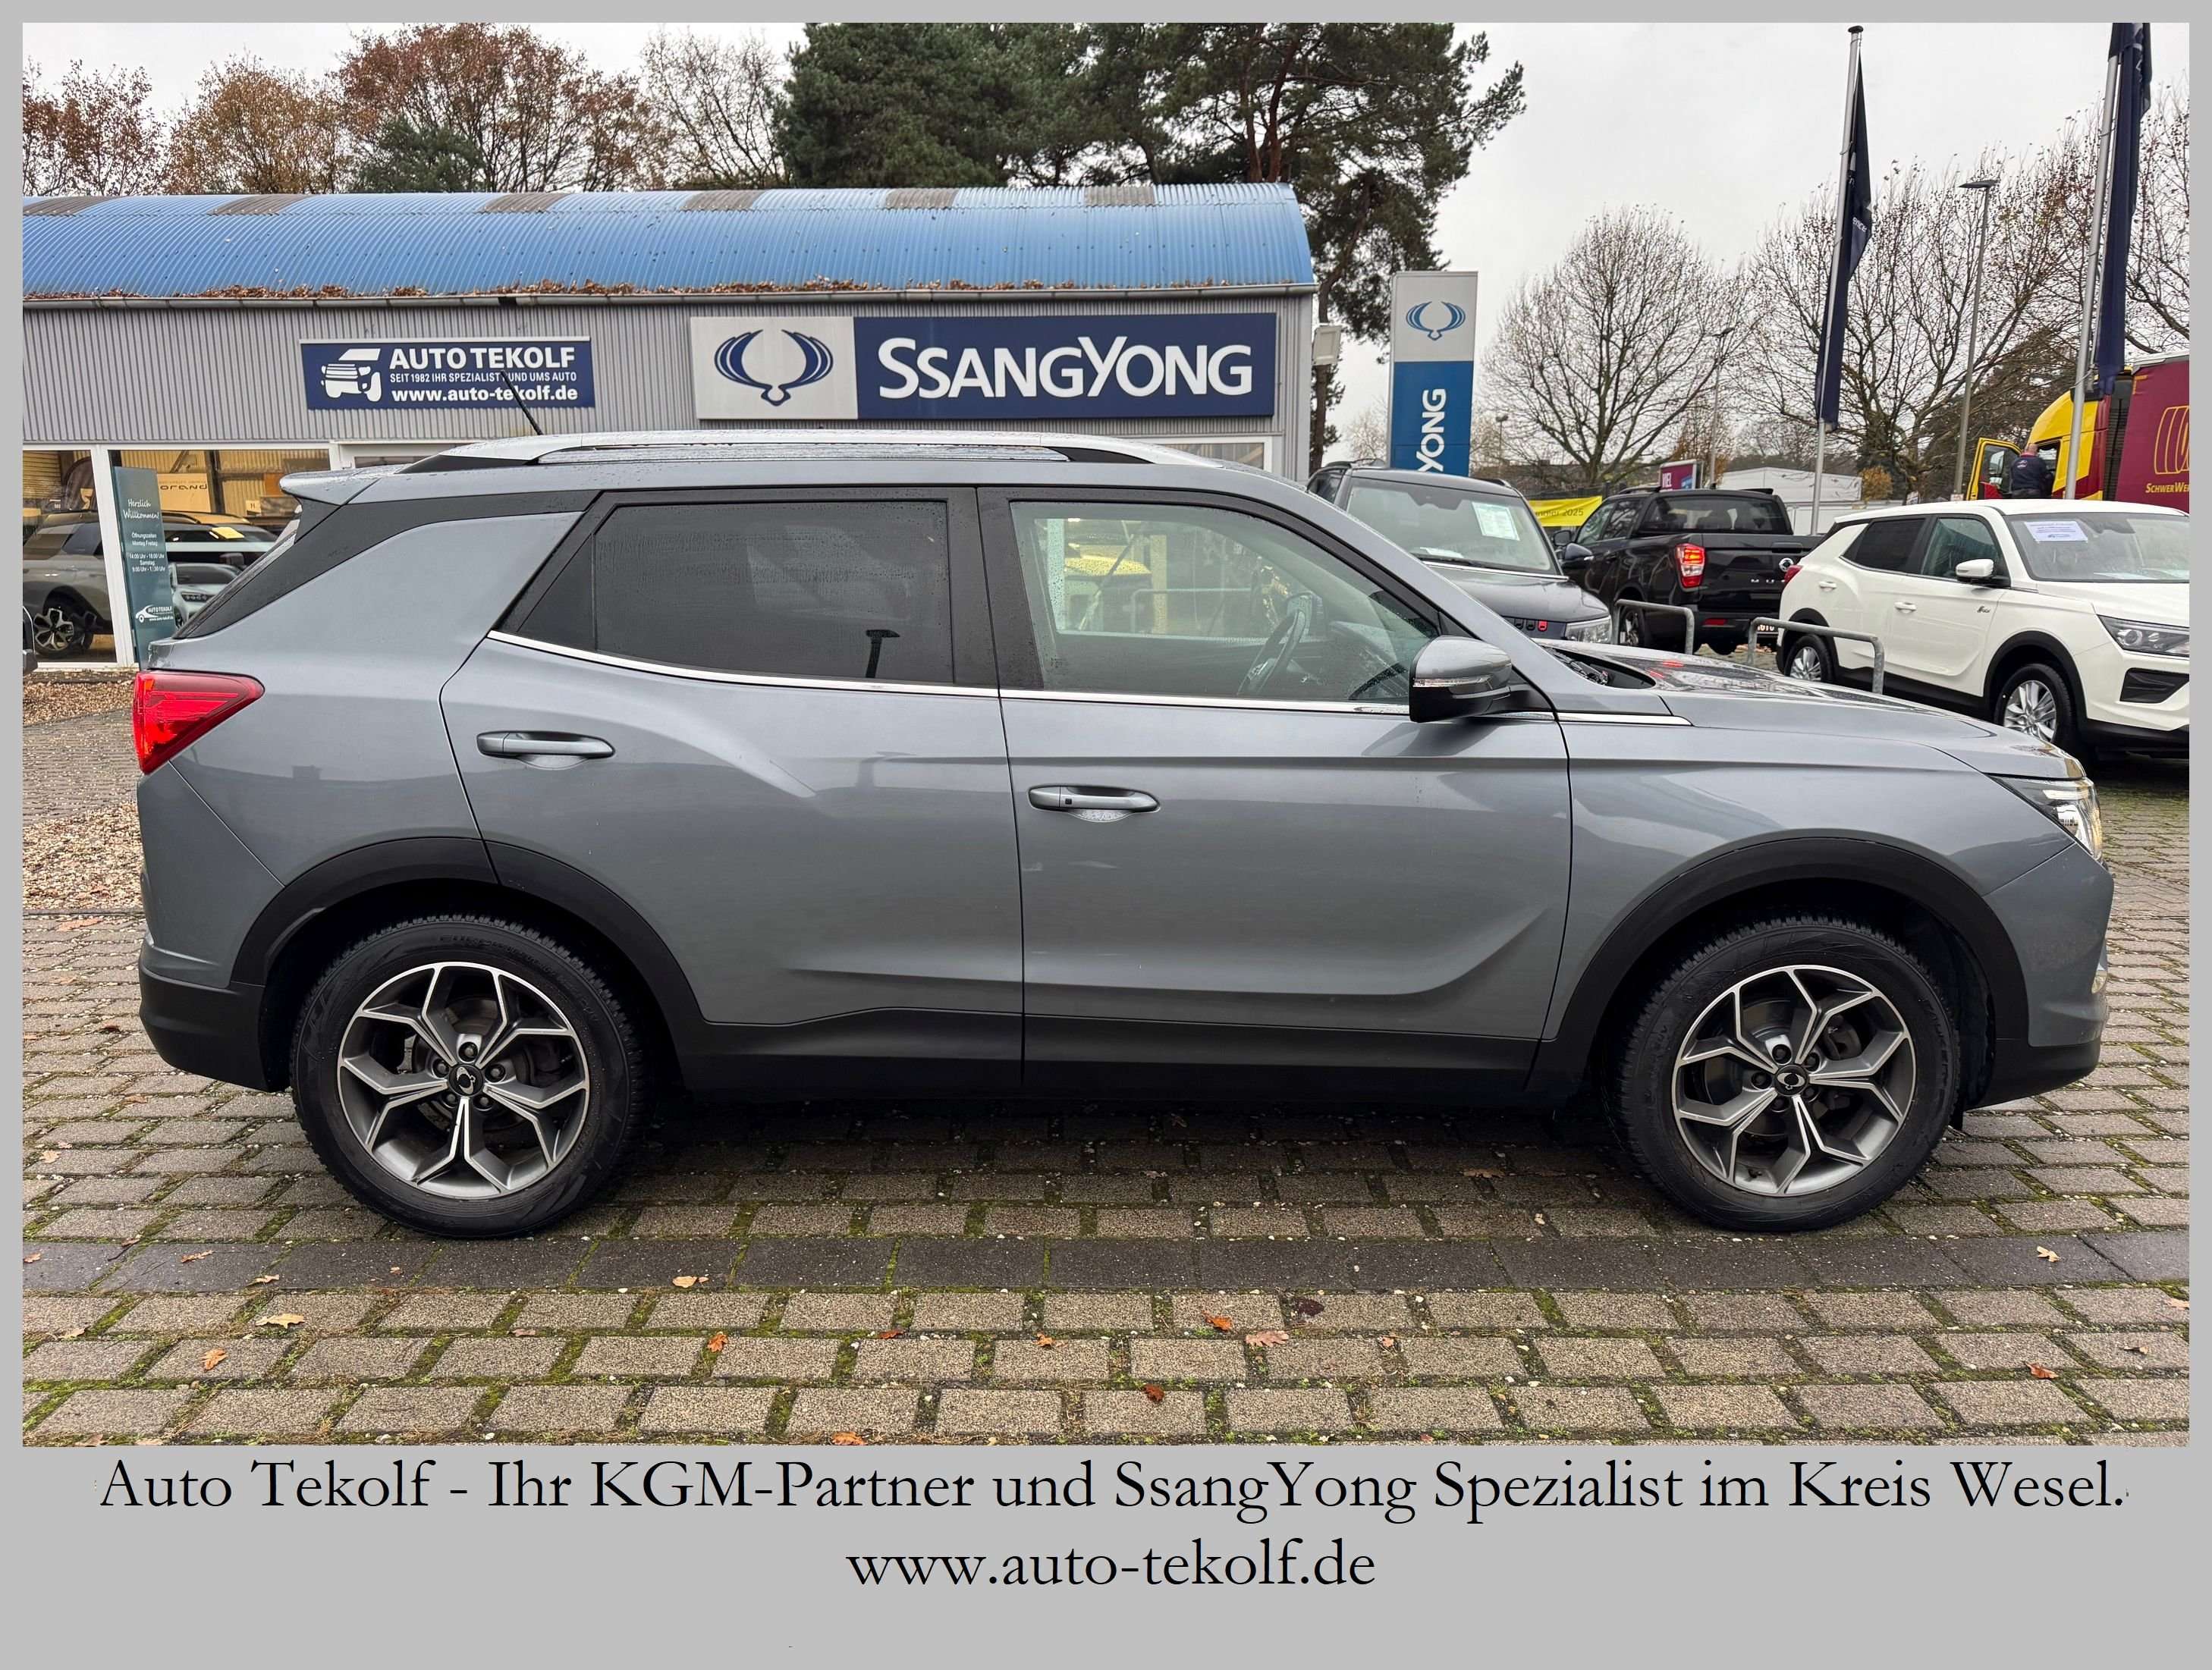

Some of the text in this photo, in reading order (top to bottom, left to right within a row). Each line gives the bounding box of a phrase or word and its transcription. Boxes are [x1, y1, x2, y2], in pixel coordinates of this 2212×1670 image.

[389, 347, 575, 369] AUTO TEKOLF
[878, 336, 1252, 399] SSANGYONG
[390, 372, 577, 383] SEIT 1982 IHR SPEZIALIST UND UMS AUTO
[391, 385, 578, 401] www.auto-tekolf.de
[1415, 388, 1447, 472] YONG
[127, 498, 152, 507] Herzlich
